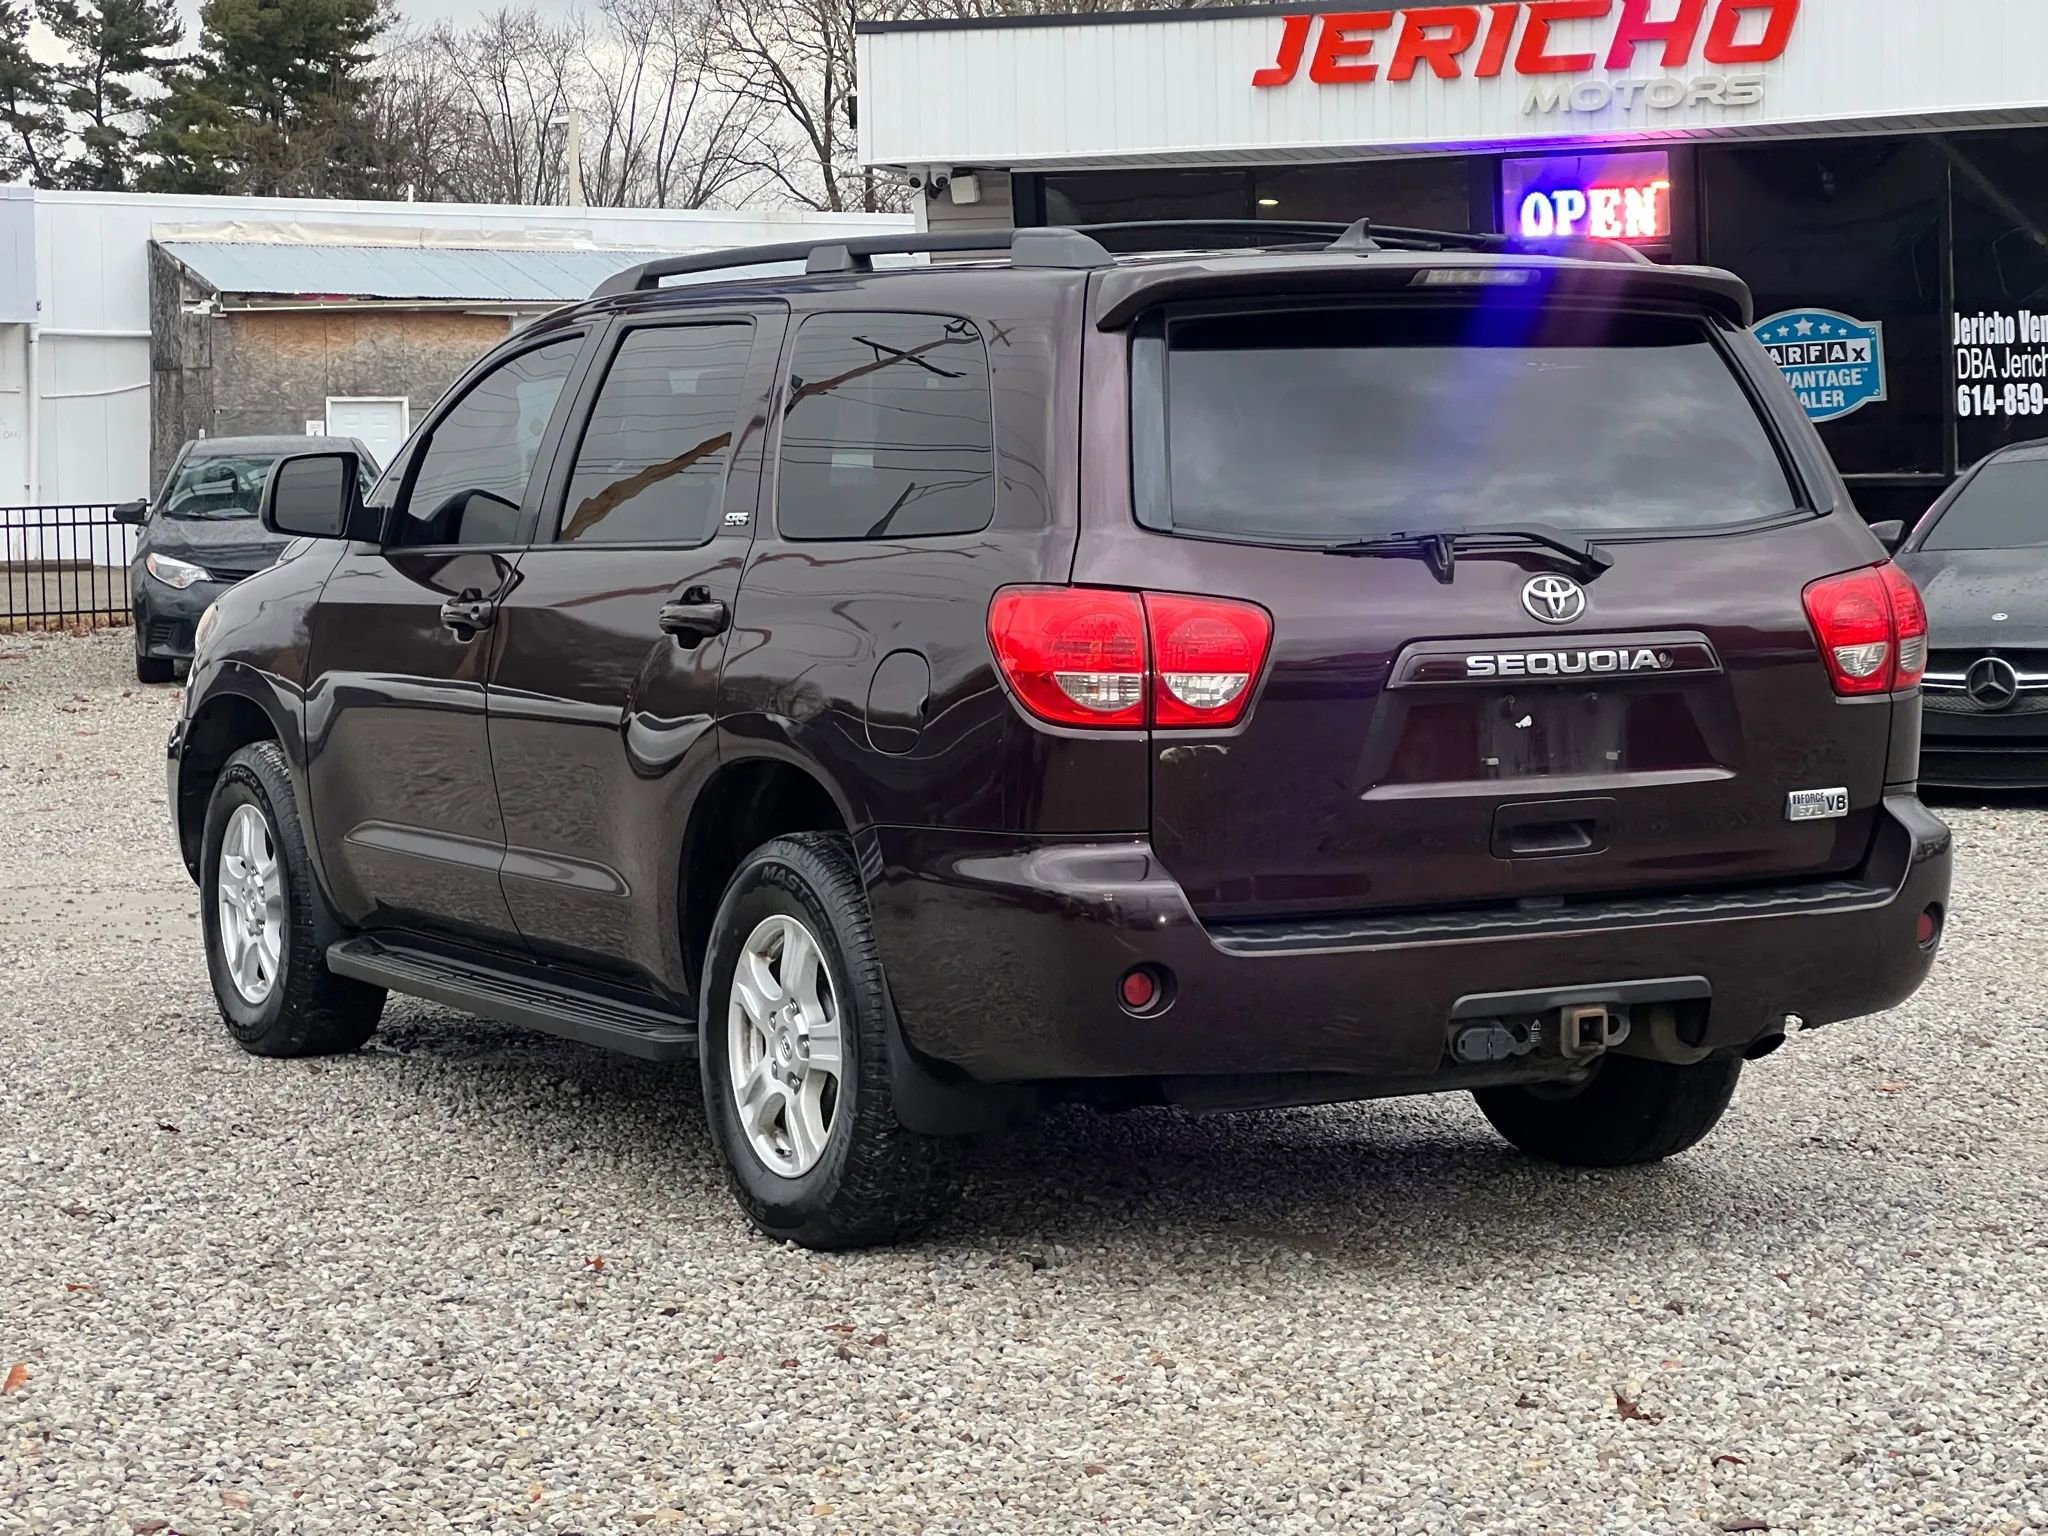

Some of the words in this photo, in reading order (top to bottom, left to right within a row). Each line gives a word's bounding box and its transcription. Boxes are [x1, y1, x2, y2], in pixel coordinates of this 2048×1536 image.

[1252, 0, 1798, 86] JERICHO
[1521, 73, 1766, 114] MOTORS
[1520, 187, 1657, 237] OPEN
[1954, 311, 2015, 345] Jericho
[1768, 344, 1865, 363] ARFAX
[1957, 347, 1997, 379] DBA
[1800, 390, 1844, 408] ALER
[1466, 650, 1661, 676] SEQUOIA
[1826, 795, 1846, 810] V8
